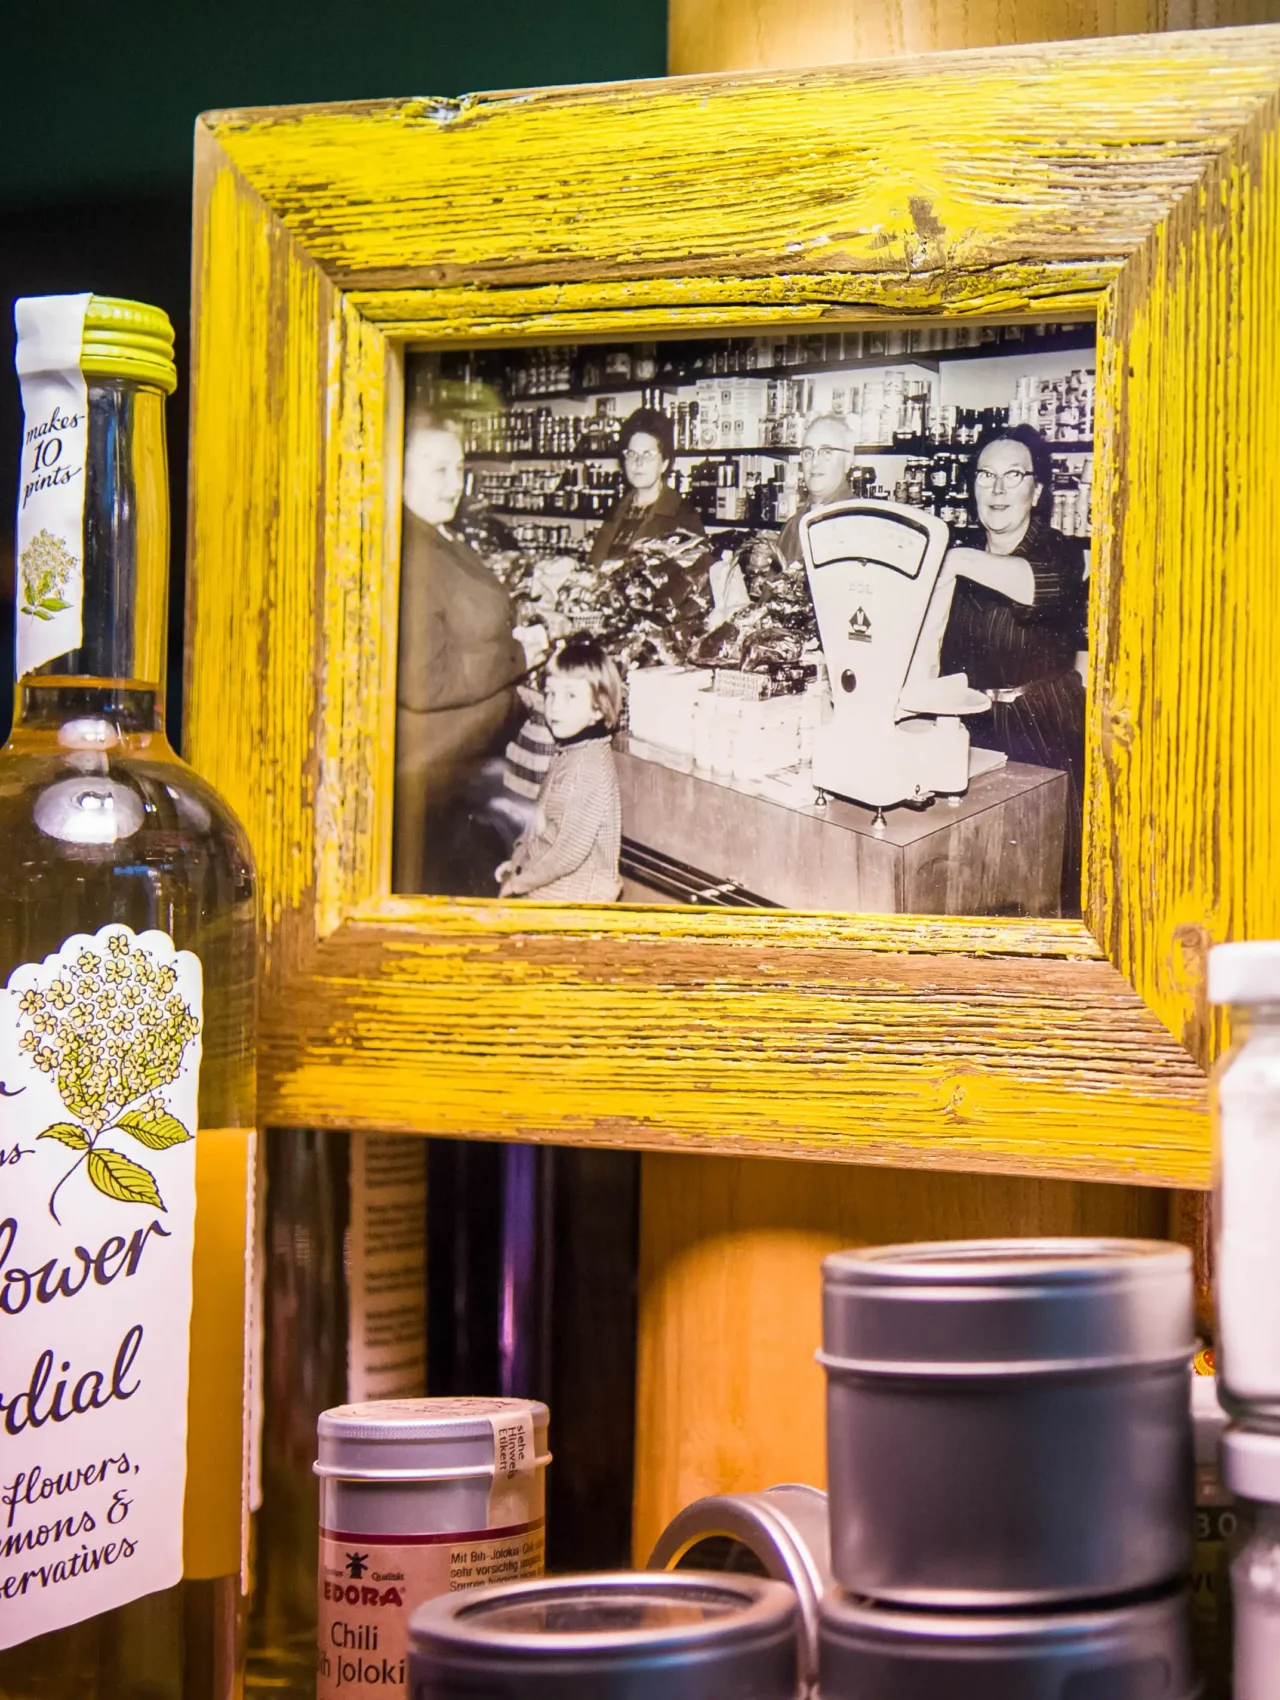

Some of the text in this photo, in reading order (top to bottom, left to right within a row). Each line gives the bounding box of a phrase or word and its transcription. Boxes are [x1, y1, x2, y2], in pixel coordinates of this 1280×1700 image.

[26, 407, 85, 445] makes
[31, 438, 62, 473] 10
[23, 466, 82, 509] pints
[499, 1429, 508, 1470] Etikett
[508, 1427, 518, 1480] Hinweis
[517, 1425, 526, 1460] siehe
[2, 1452, 140, 1528] flowers,
[107, 1489, 134, 1524] &
[450, 1568, 472, 1578] sehr
[476, 1561, 518, 1576] vorsichtig
[451, 1552, 467, 1564] Mit
[324, 1581, 402, 1607] EDORA
[331, 1622, 378, 1650] Chili
